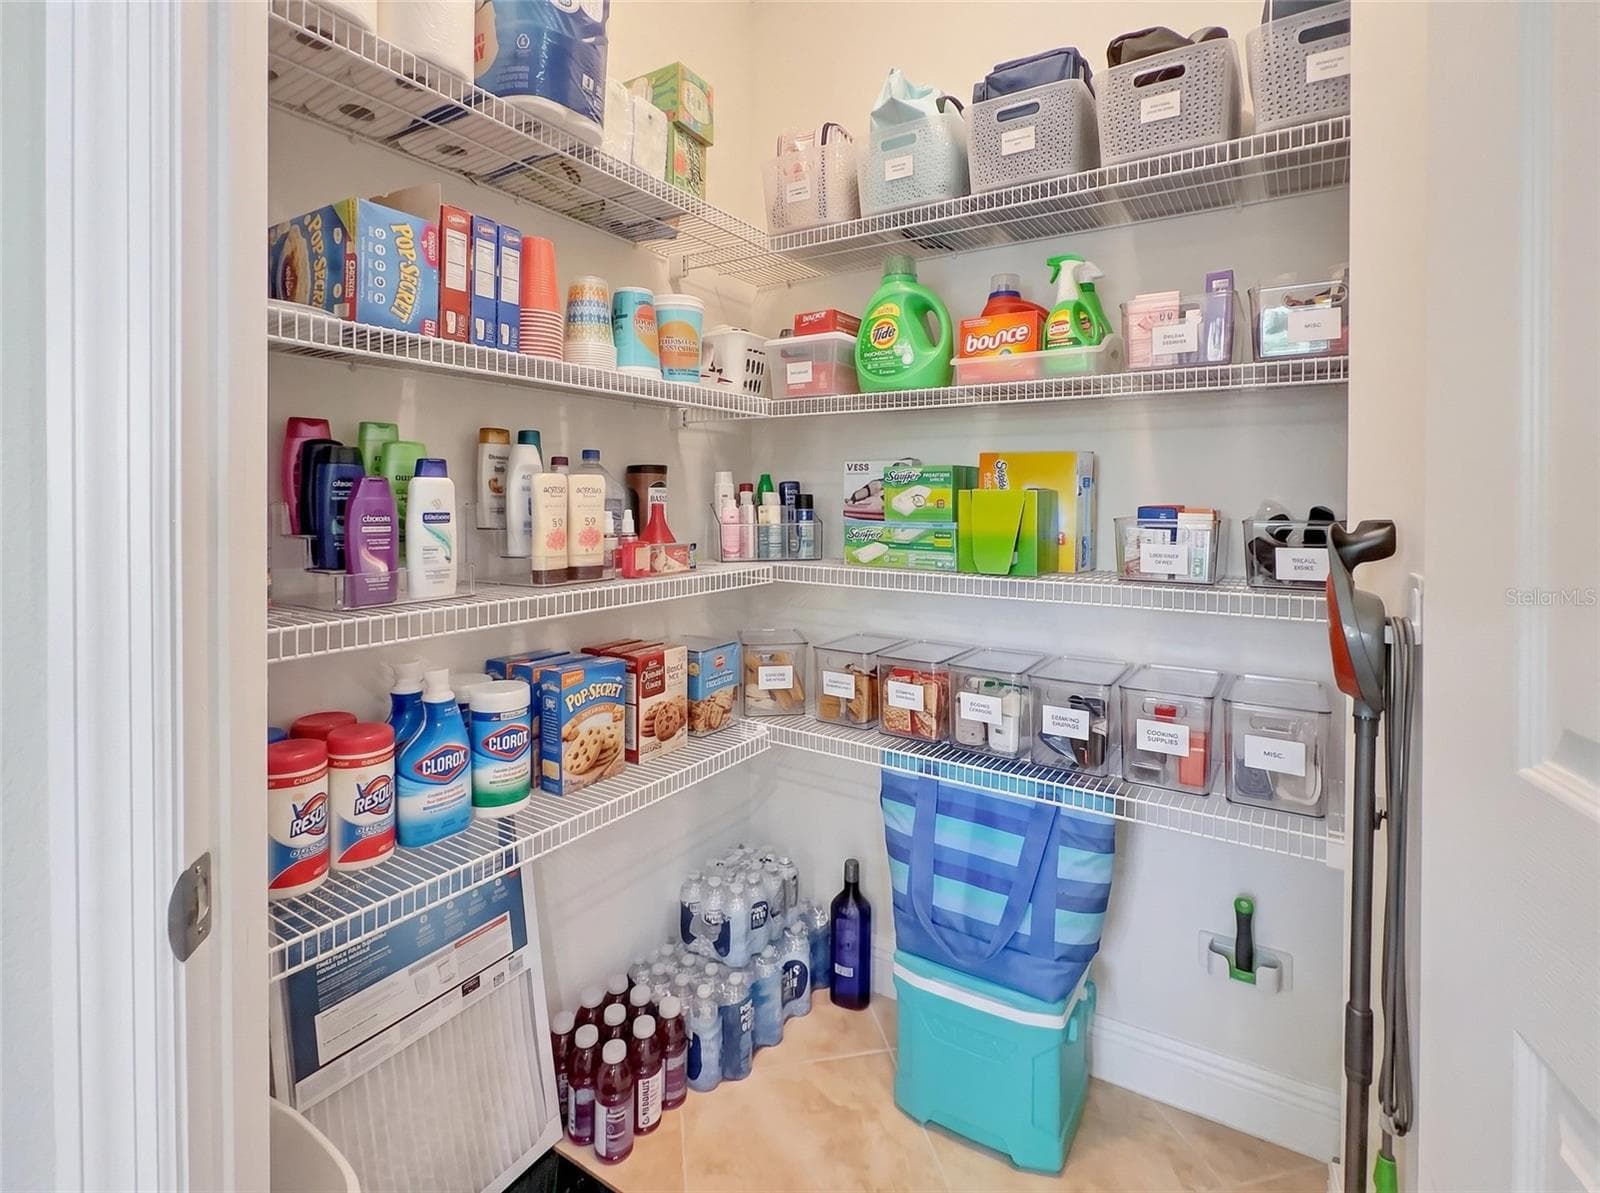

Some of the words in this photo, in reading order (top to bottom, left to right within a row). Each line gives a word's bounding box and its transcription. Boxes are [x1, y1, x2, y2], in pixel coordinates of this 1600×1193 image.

[873, 326, 897, 342] Tide
[965, 325, 1029, 352] bounce
[846, 463, 870, 472] VESS
[1146, 728, 1179, 739] COOKING
[1147, 735, 1179, 746] SUPPLIES
[422, 750, 466, 775] CLOROX
